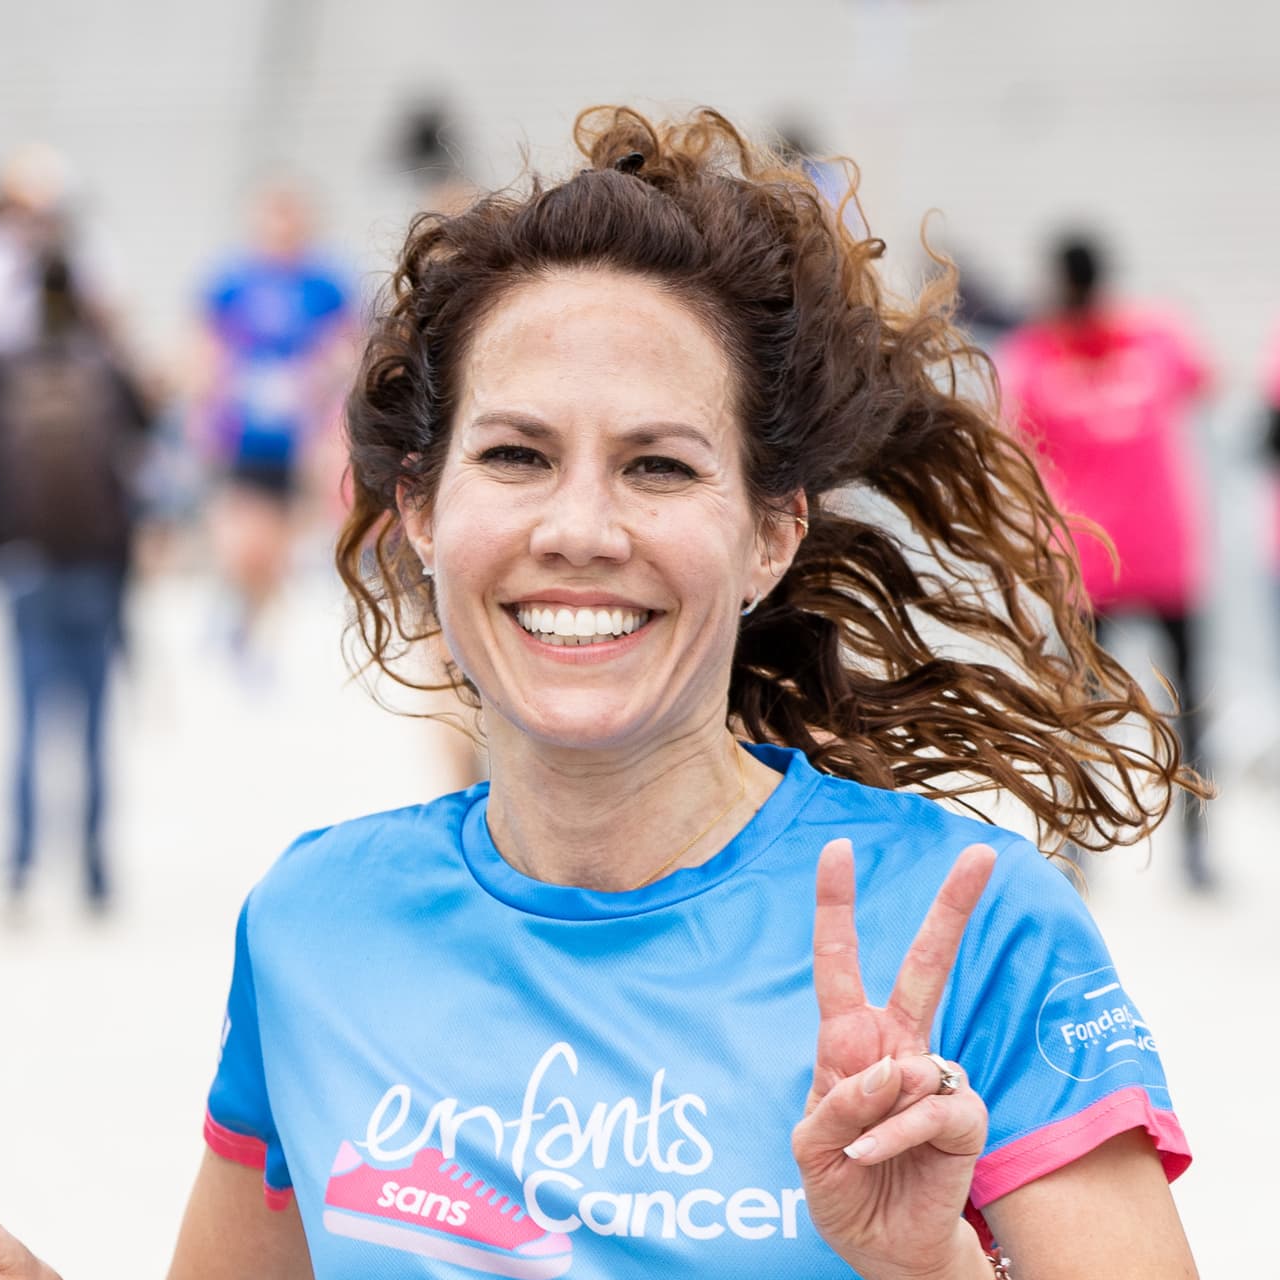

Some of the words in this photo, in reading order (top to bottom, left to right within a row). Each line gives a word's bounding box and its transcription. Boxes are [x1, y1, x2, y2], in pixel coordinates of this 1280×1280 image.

[355, 1042, 713, 1182] enfants
[377, 1179, 470, 1228] sans
[522, 1170, 806, 1241] Cancer
